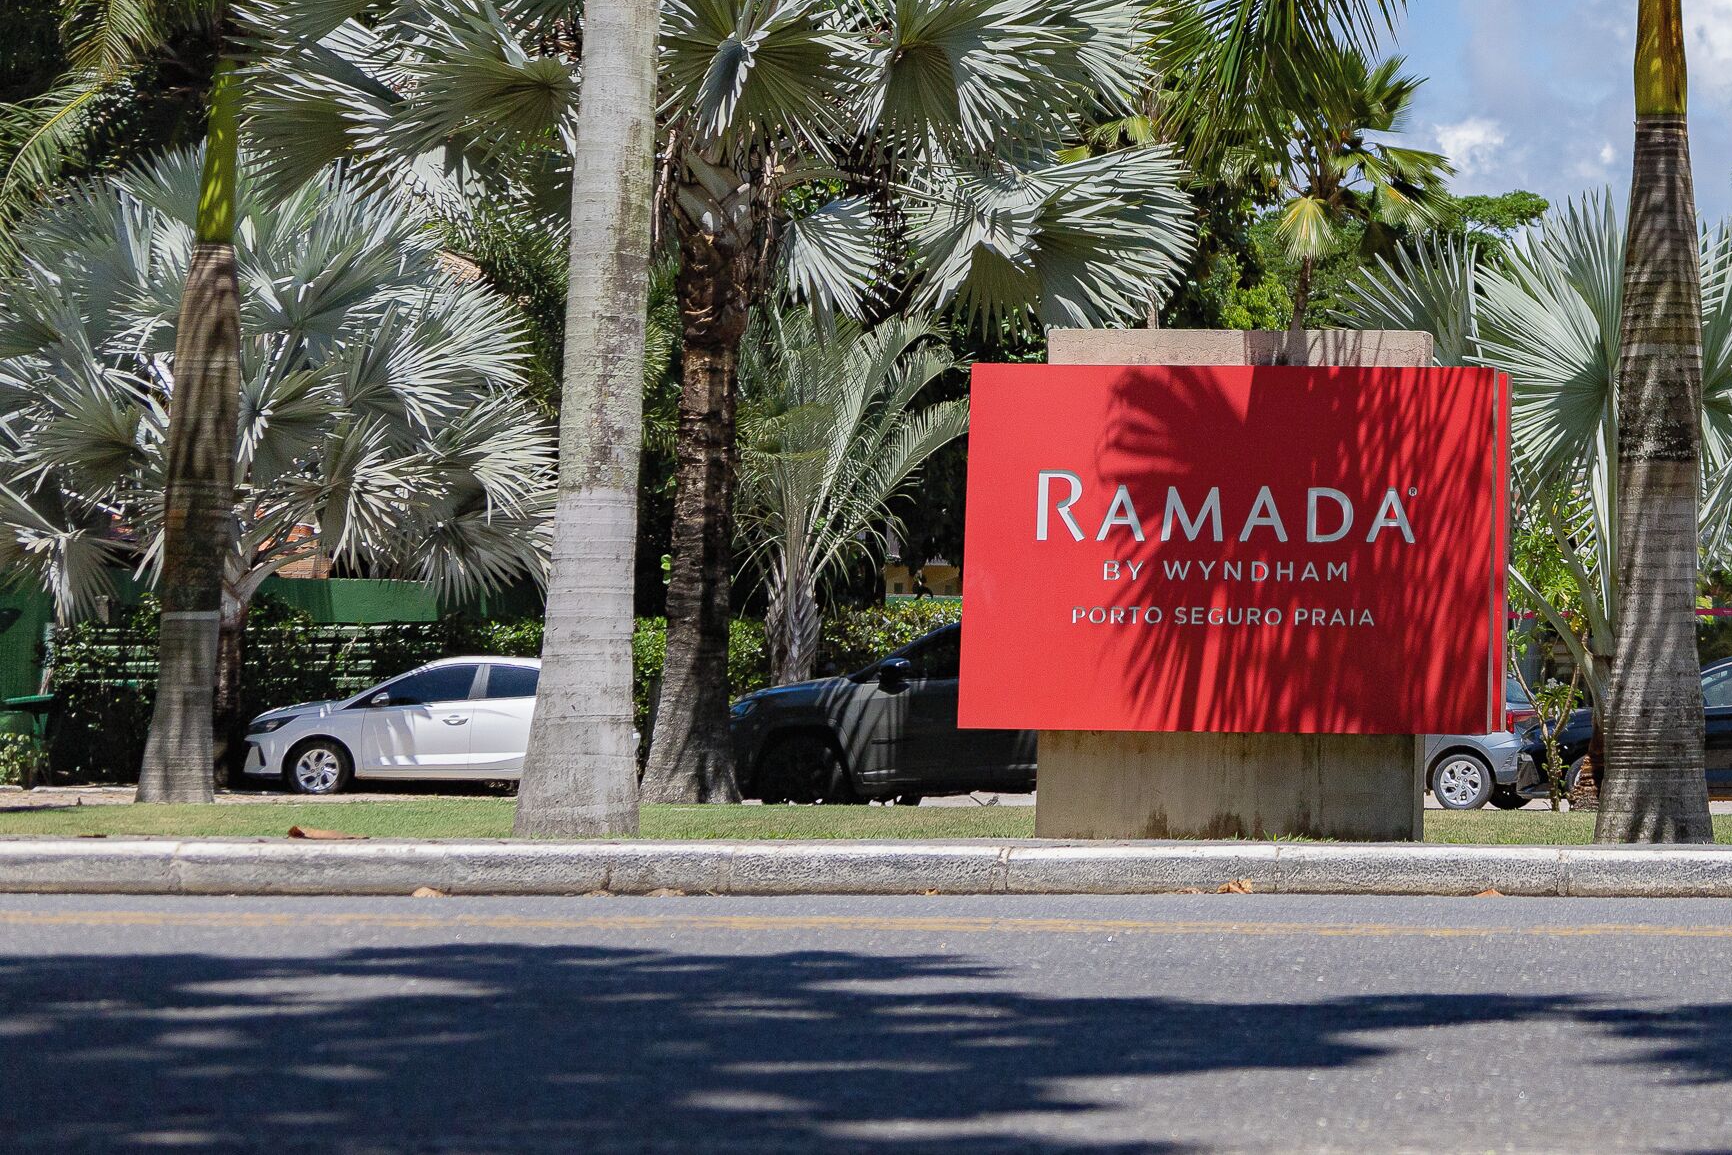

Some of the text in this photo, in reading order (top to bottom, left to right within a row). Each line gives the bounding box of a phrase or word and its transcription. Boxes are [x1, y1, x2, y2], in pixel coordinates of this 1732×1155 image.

[1103, 560, 1348, 582] BY WYNDHAM
[1071, 606, 1375, 626] PORTO SEGURO PRAIA
